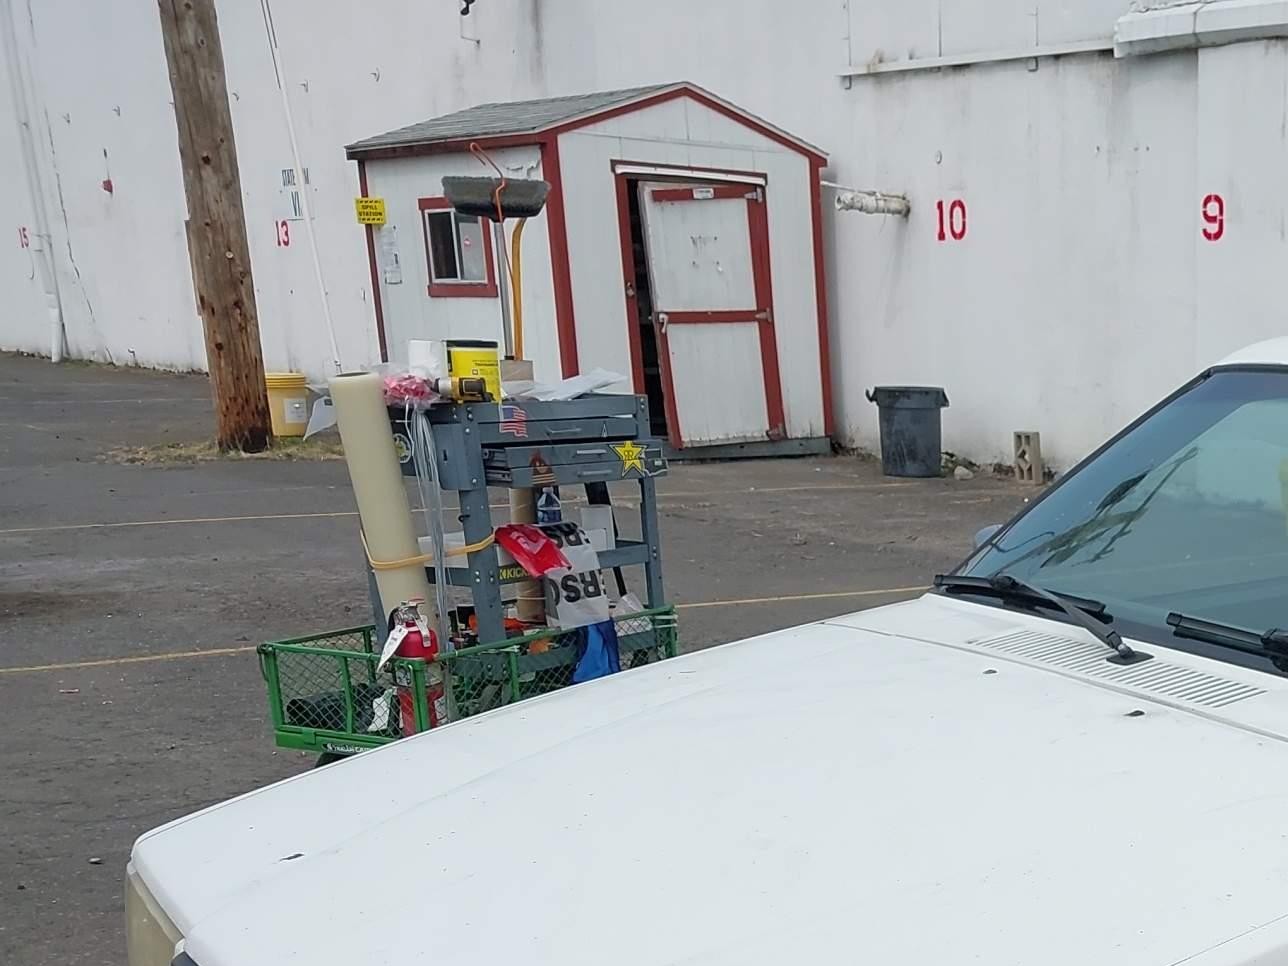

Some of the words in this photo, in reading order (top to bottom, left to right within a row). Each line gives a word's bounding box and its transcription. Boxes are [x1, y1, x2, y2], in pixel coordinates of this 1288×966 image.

[275, 220, 290, 247] 13
[936, 199, 967, 241] 10
[1202, 194, 1225, 242] 9
[18, 227, 30, 249] 15
